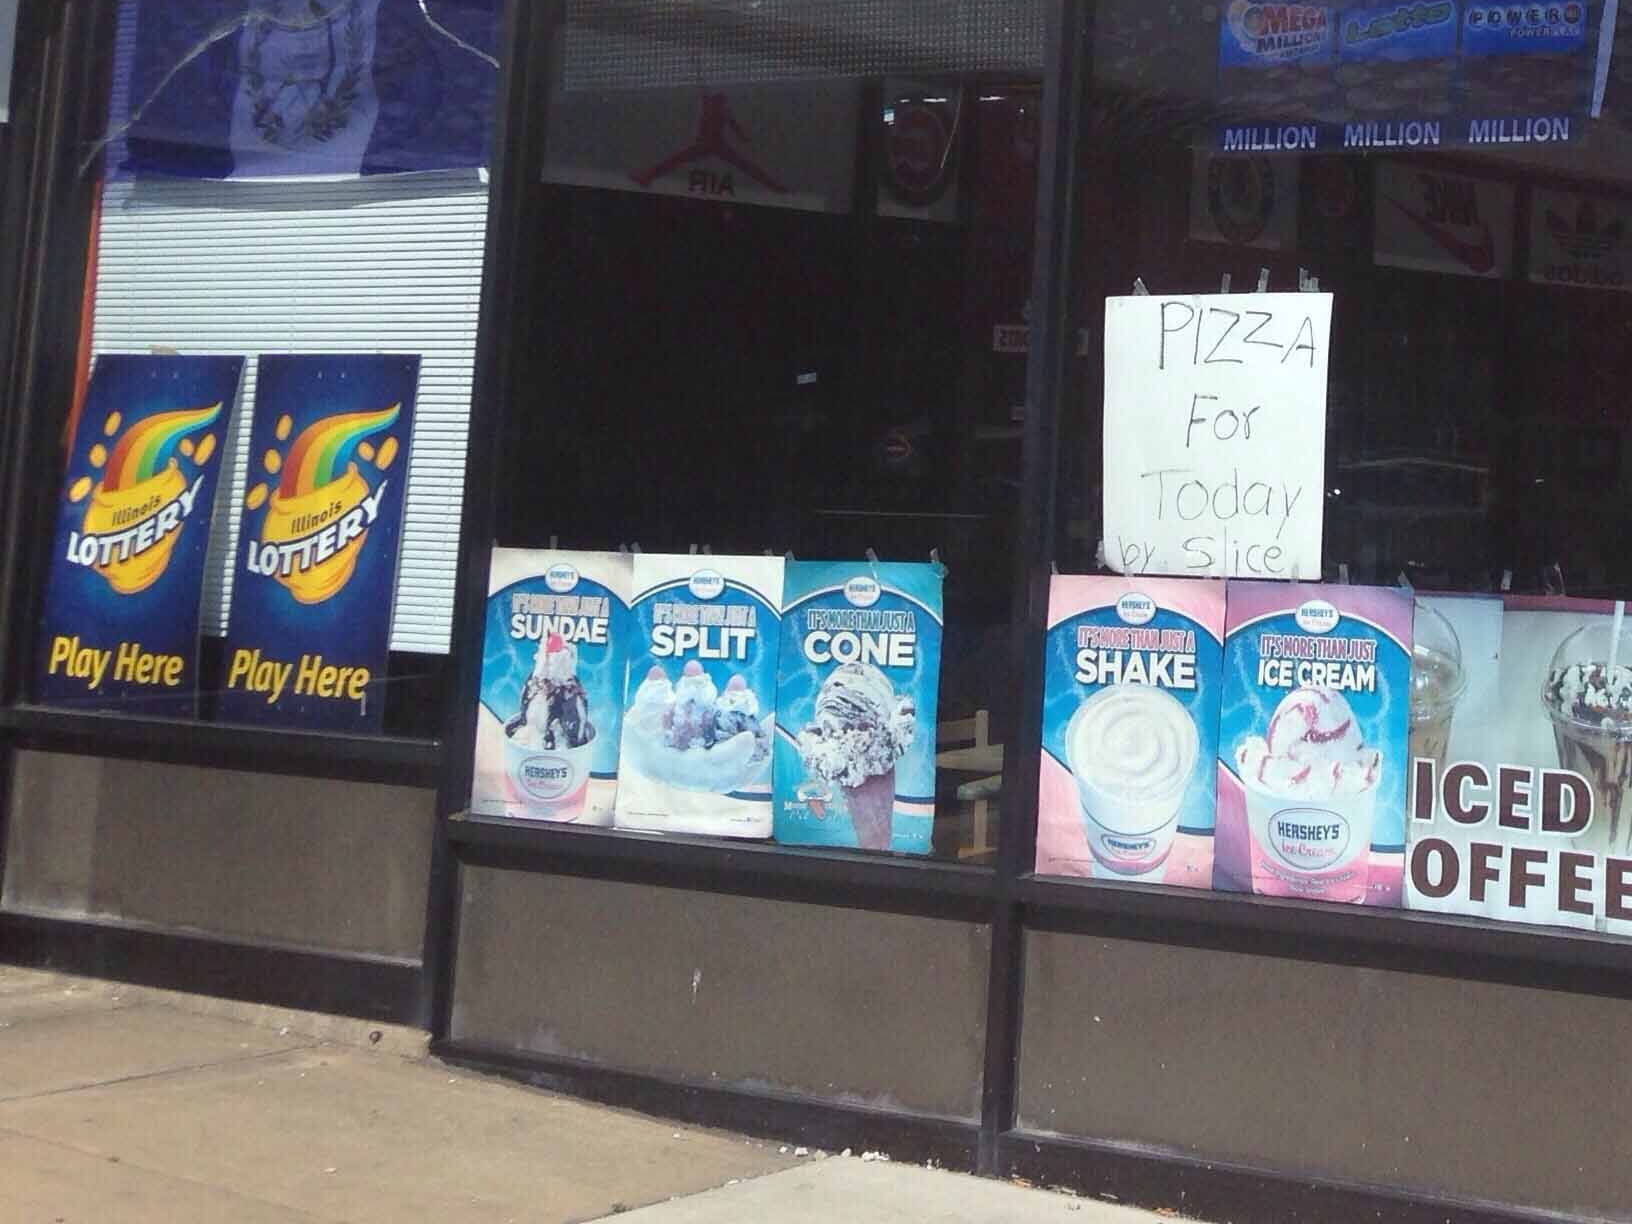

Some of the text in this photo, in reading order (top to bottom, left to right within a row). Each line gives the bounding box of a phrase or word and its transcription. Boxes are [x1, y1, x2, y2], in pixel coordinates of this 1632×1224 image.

[1224, 126, 1317, 151] MILLION
[1344, 121, 1440, 147] MILLION
[1468, 116, 1570, 143] MILLION
[1158, 301, 1316, 370] PIZZA
[1186, 393, 1260, 448] For
[112, 493, 162, 526] Illinois
[290, 500, 342, 534] Illinois
[1141, 468, 1302, 539] Today
[65, 475, 204, 568] LOTTERY
[247, 479, 388, 576] LOTTERY
[1118, 528, 1285, 575] by Slice
[511, 613, 608, 644] SUNDAE
[650, 624, 756, 659] SPLIT
[1100, 626, 1130, 649] MORE
[1130, 627, 1160, 651] THAN
[1160, 628, 1186, 653] JUST
[1185, 630, 1196, 653] A
[49, 637, 184, 690] Play Here
[804, 630, 916, 666] CONE
[1261, 634, 1377, 663] IT'S MORE THAN JUST
[227, 649, 370, 704] Play Here
[1075, 649, 1196, 688] SHAKE
[1258, 659, 1376, 692] ICE CREAM
[1414, 759, 1594, 835] ICED
[1277, 820, 1340, 841] HERSHEY'S
